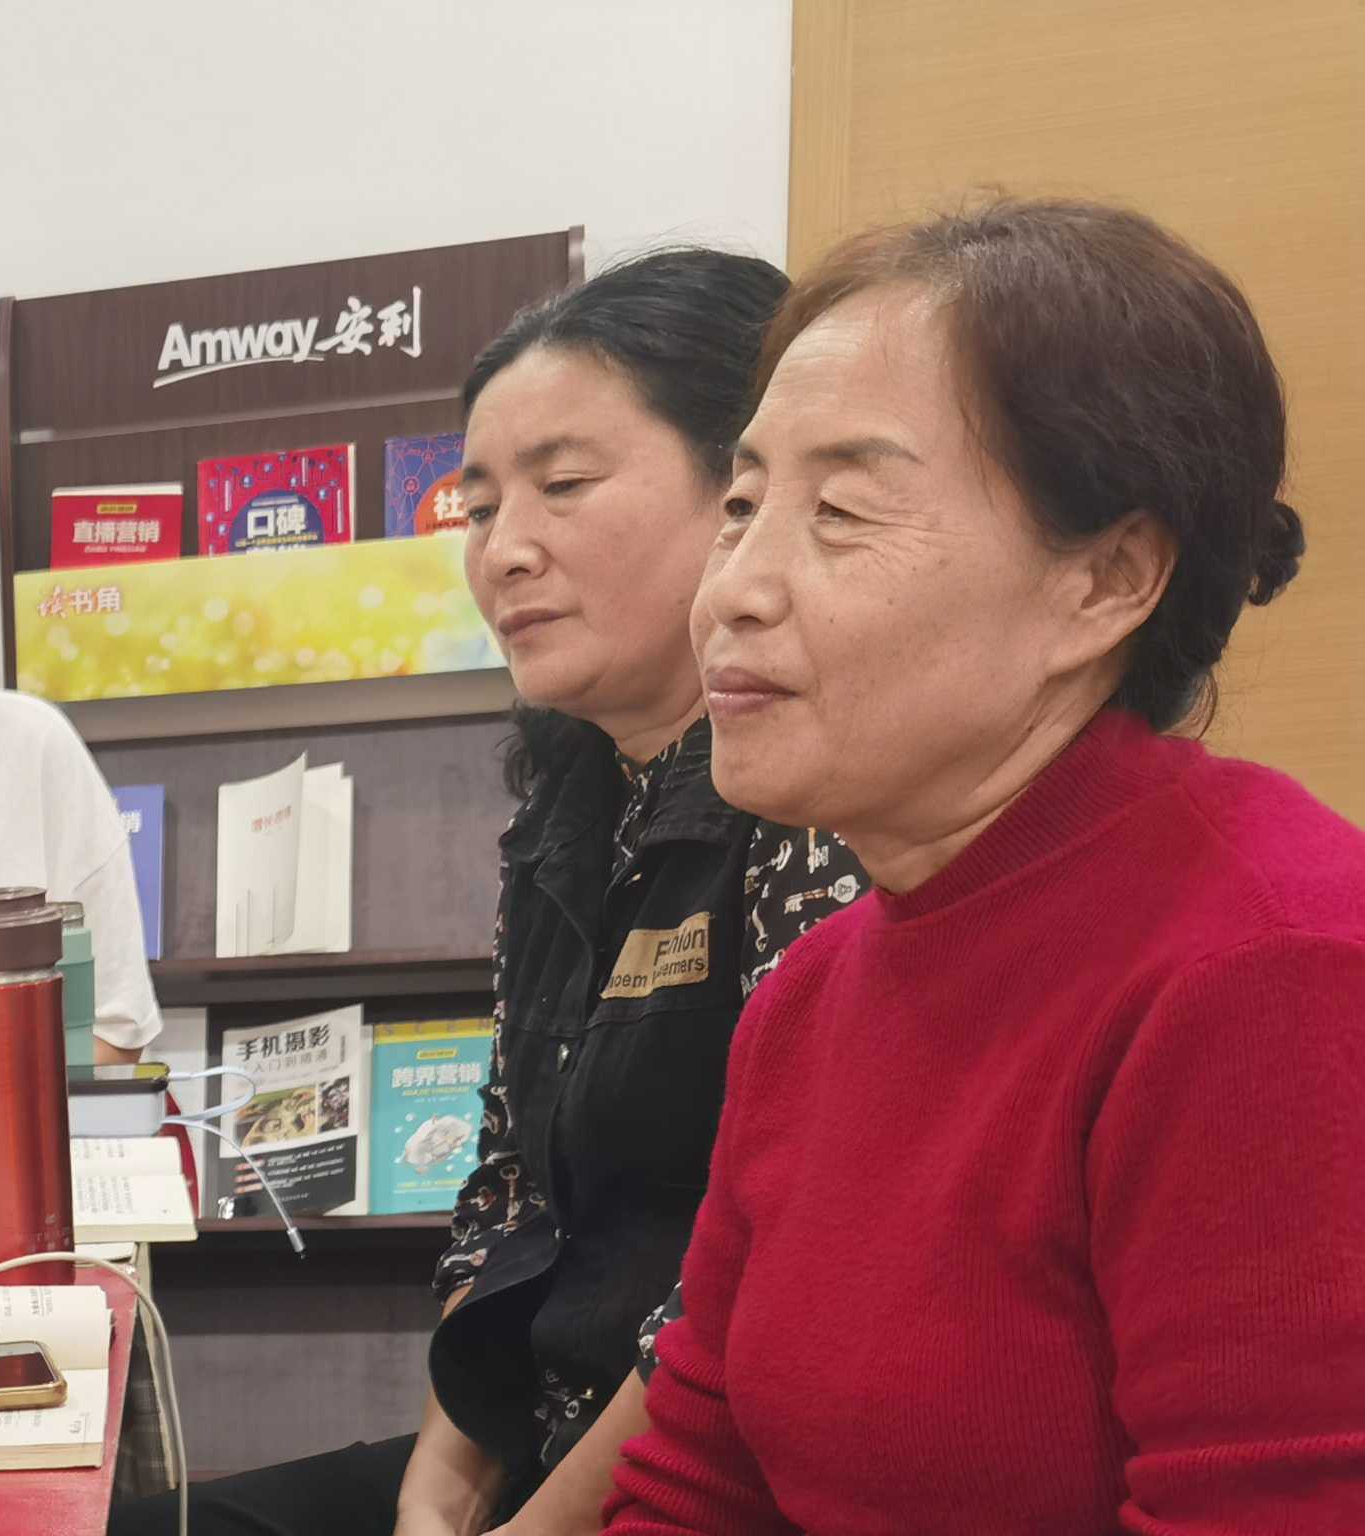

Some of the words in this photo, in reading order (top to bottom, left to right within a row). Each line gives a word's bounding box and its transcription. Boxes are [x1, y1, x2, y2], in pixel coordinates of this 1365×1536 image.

[315, 286, 422, 358] 安利
[157, 318, 322, 370] Amway
[72, 519, 160, 545] 直播营销
[246, 506, 307, 536] 口碑
[37, 584, 122, 618] 读书角
[237, 1023, 331, 1062] 手机摄影
[391, 1062, 482, 1089] 跨界营销
